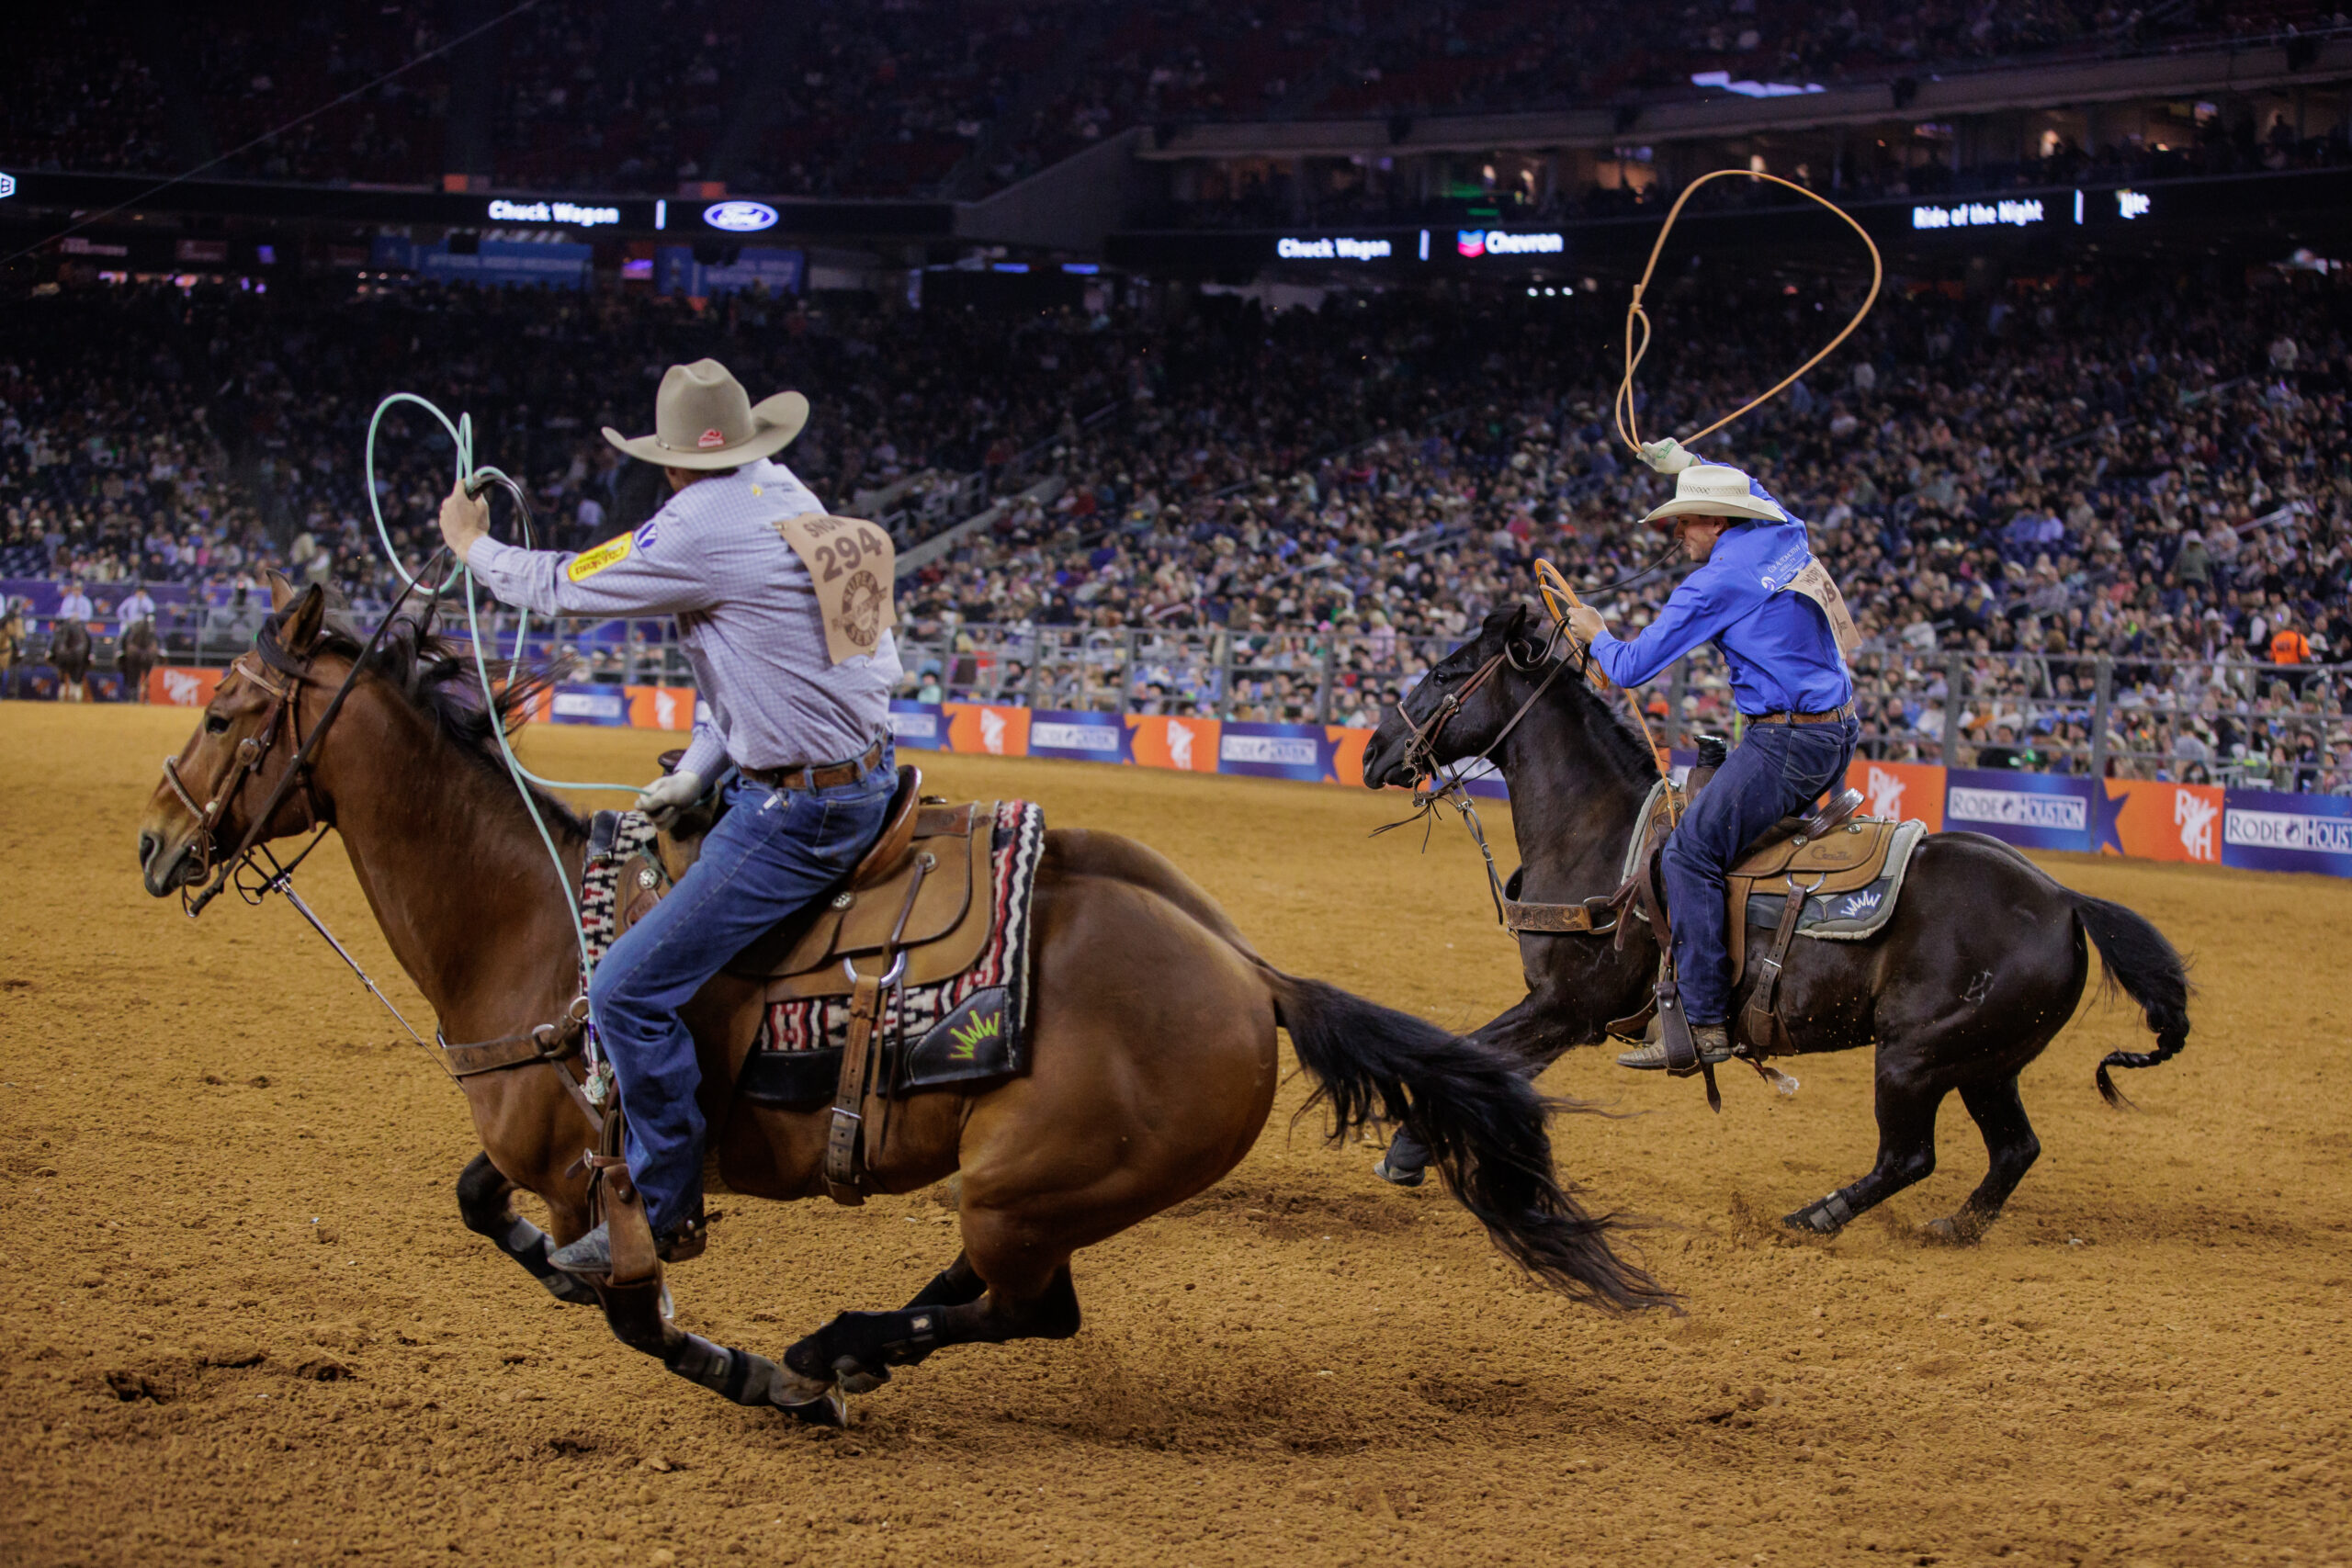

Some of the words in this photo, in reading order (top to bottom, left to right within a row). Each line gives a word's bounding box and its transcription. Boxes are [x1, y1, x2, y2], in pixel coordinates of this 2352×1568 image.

[489, 199, 551, 222] Chuck
[551, 202, 620, 227] Wagon
[1913, 205, 1950, 229] Ride
[1951, 203, 1969, 226] of
[1969, 202, 1997, 225] the
[1997, 198, 2043, 226] Night
[2119, 192, 2151, 220] Lite
[1278, 237, 1334, 258] Chuck
[1334, 237, 1392, 261] Wagon
[1485, 231, 1564, 254] Chevron
[815, 526, 883, 583] 294
[844, 570, 877, 603] SUPER
